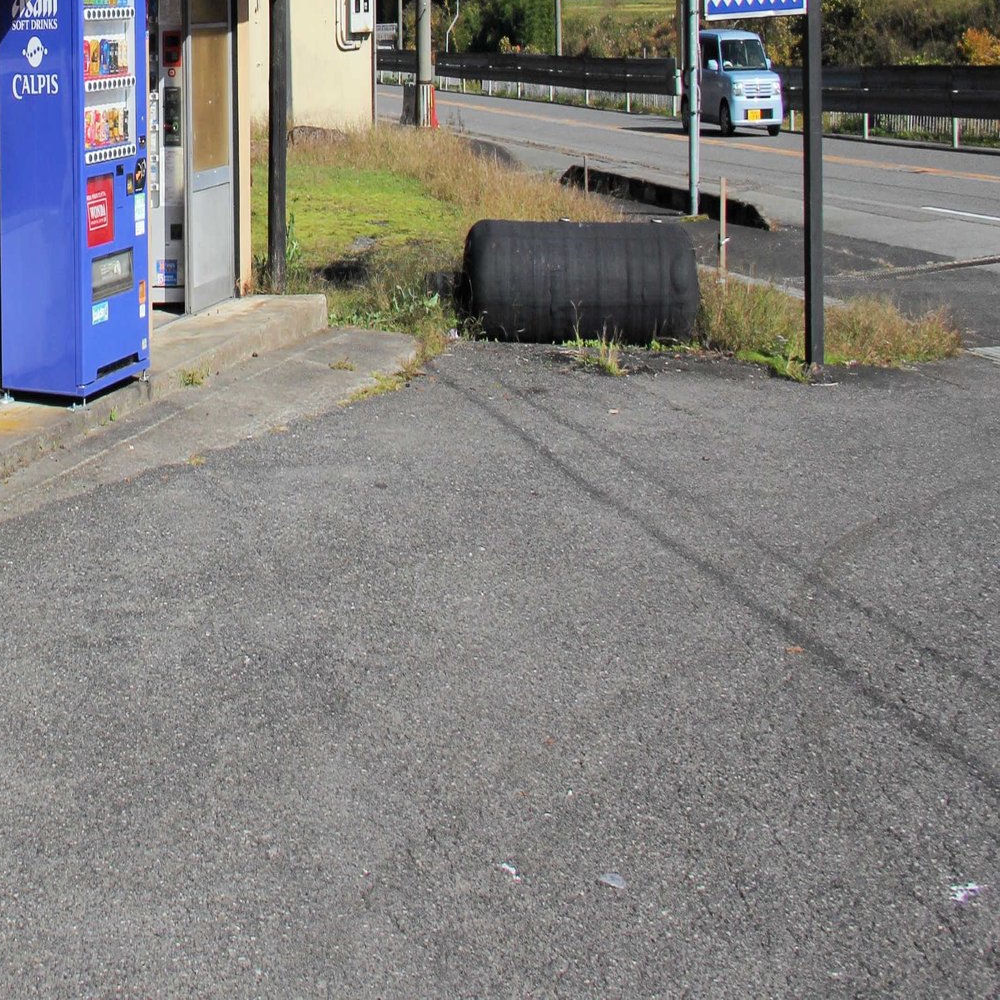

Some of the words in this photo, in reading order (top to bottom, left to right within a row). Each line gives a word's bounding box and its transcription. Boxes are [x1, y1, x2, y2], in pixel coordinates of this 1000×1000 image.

[11, 19, 29, 31] SOFT
[30, 18, 58, 30] DRINKS
[12, 74, 59, 99] CALPIS
